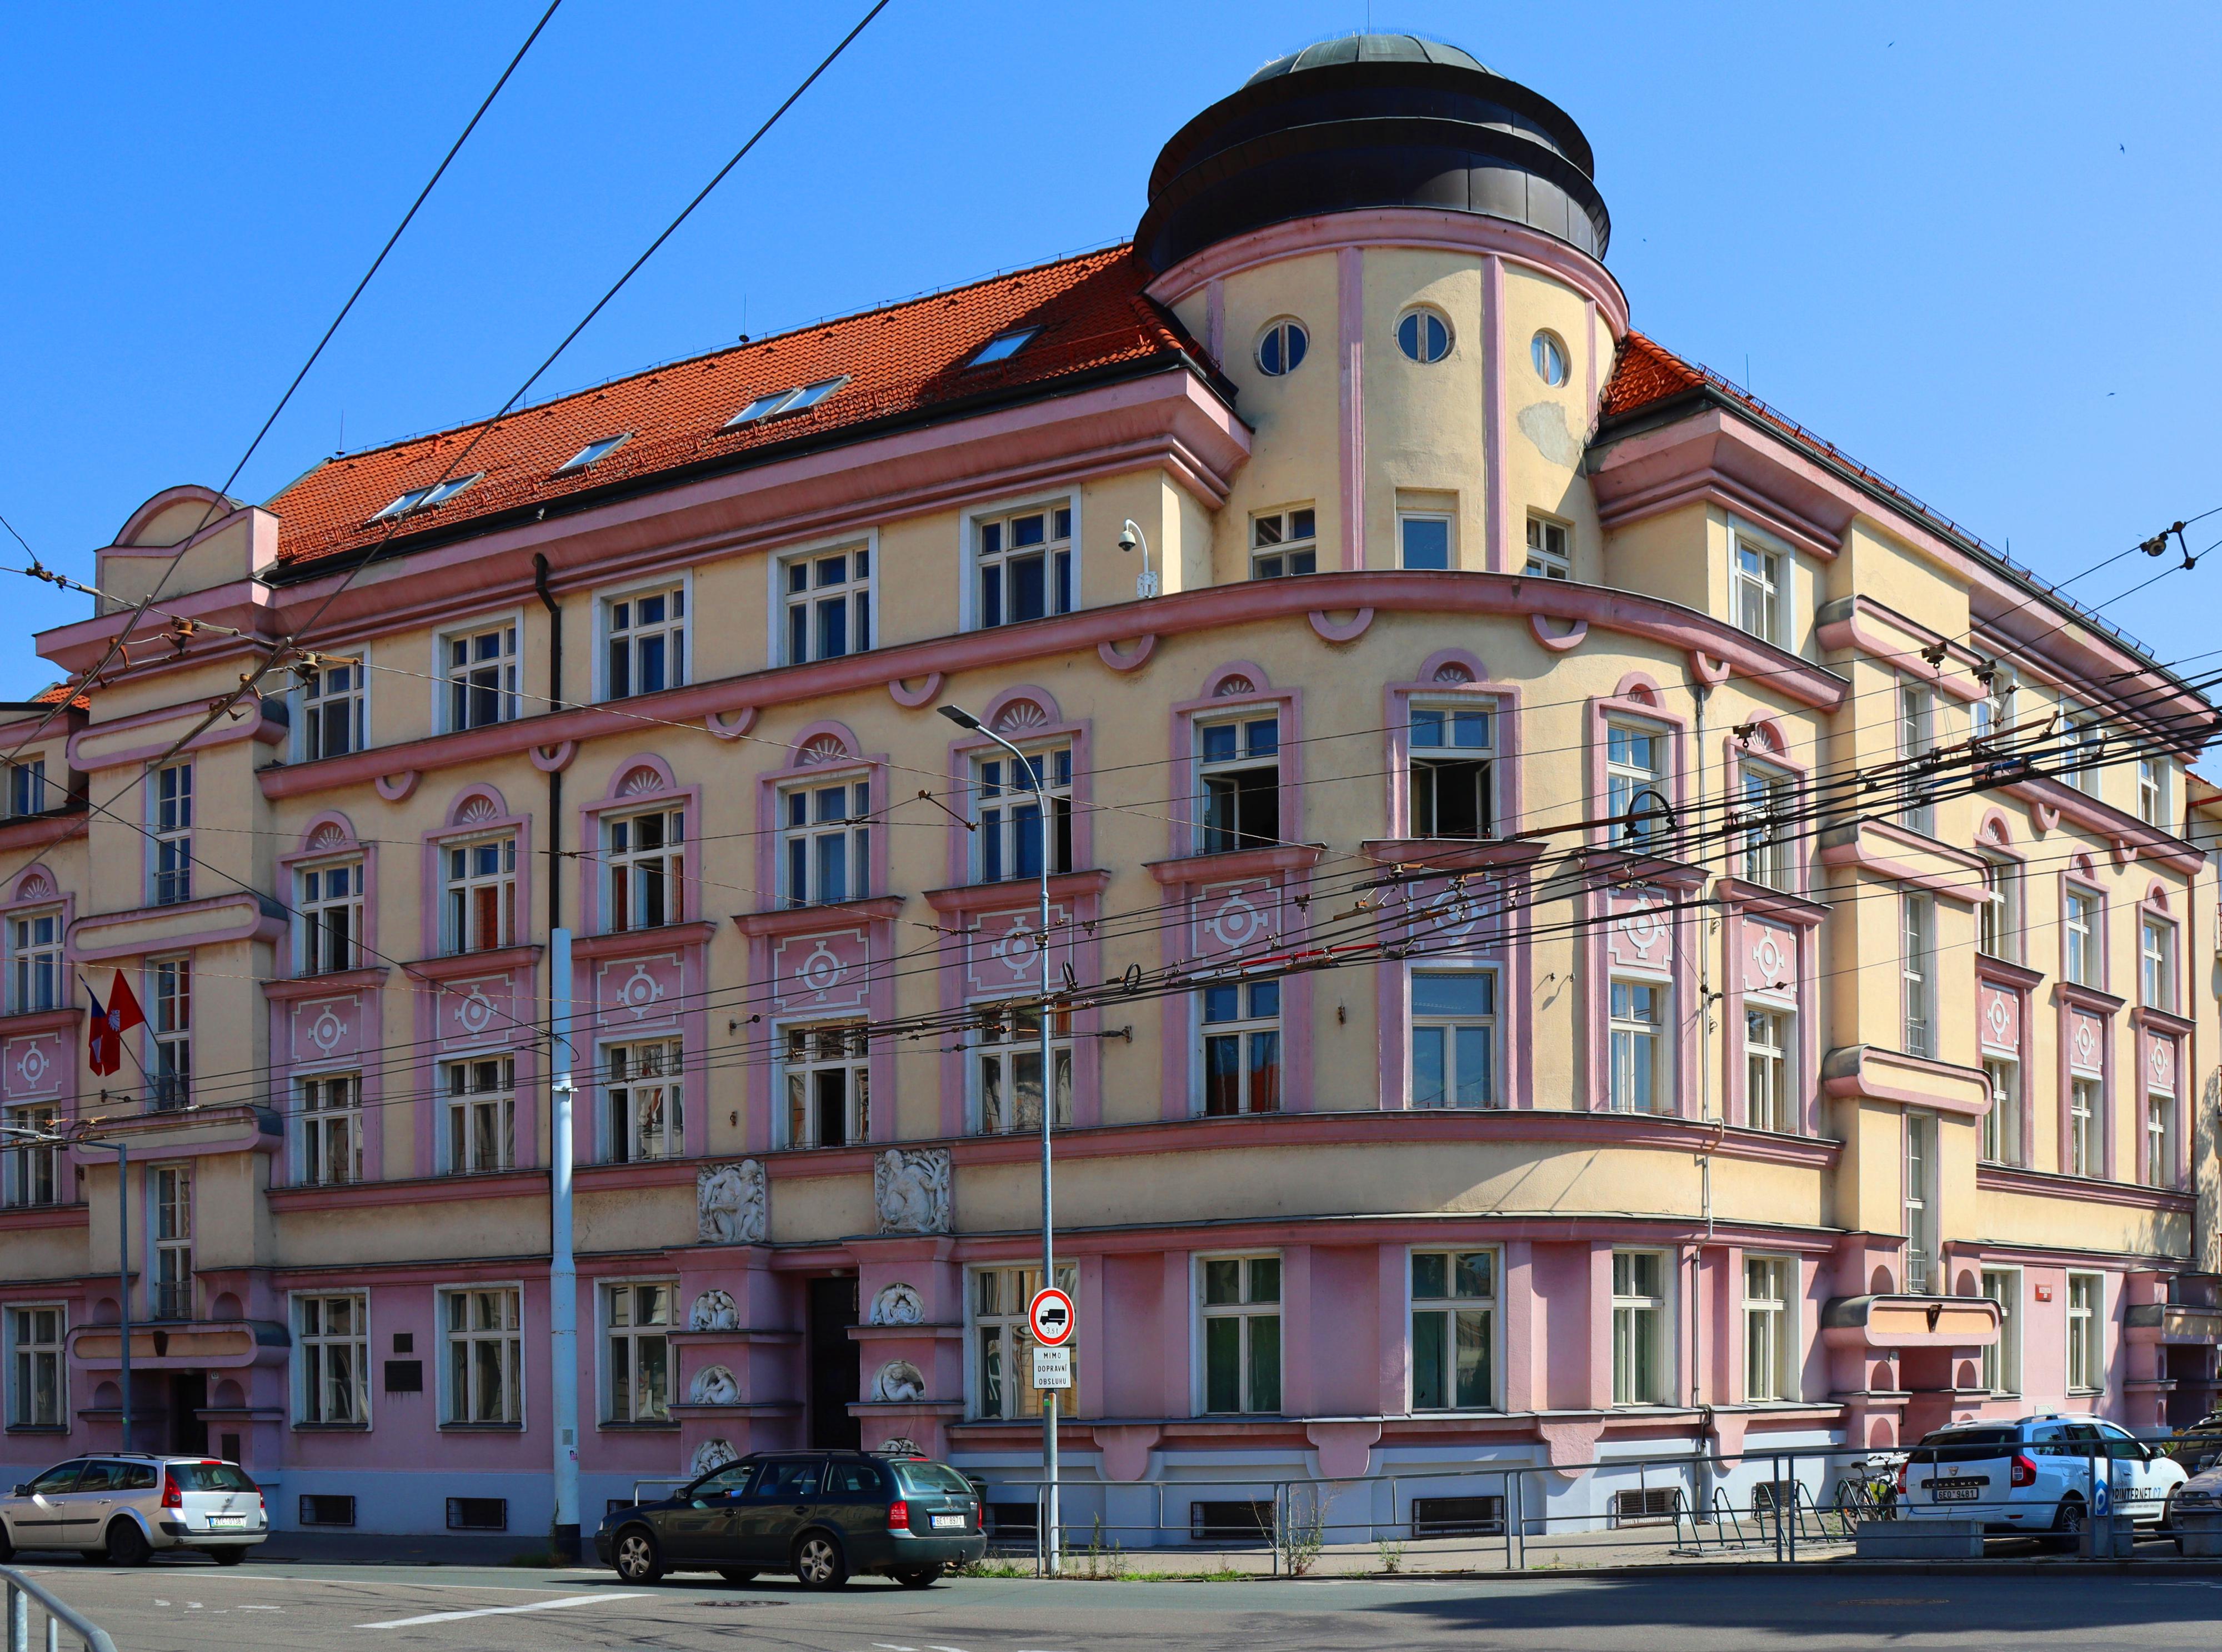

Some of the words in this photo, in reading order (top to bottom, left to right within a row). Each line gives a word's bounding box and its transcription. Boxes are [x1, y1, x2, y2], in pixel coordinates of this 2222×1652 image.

[1038, 1364, 1067, 1372] DOPRAVNÍ
[1956, 1490, 1974, 1498] 9481
[949, 1516, 962, 1525] 8971
